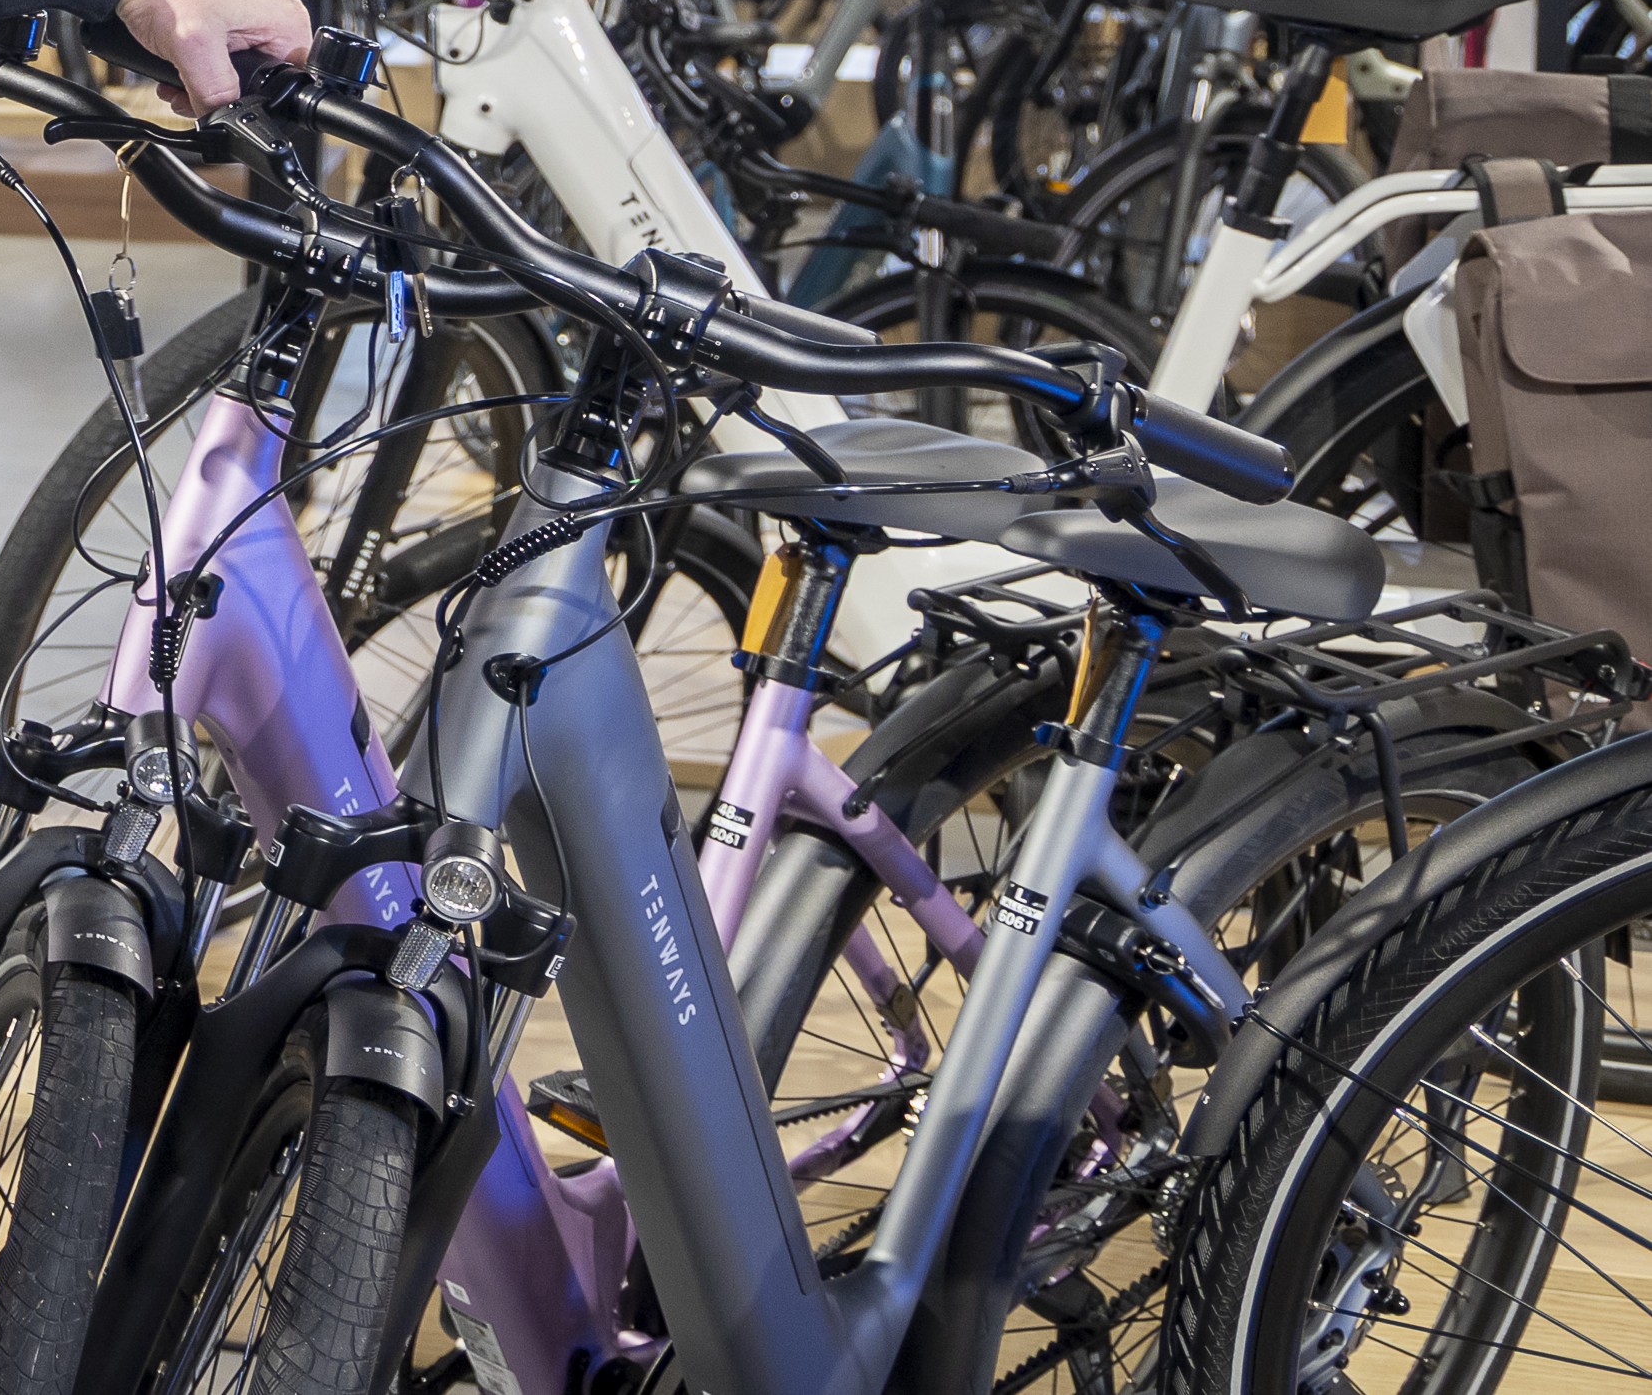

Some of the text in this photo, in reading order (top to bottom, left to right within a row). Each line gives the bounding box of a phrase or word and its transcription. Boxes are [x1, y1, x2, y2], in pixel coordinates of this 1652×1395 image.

[341, 529, 381, 599] TENWAYS
[640, 873, 697, 1026] TENWAYS
[997, 909, 1034, 933] 6061
